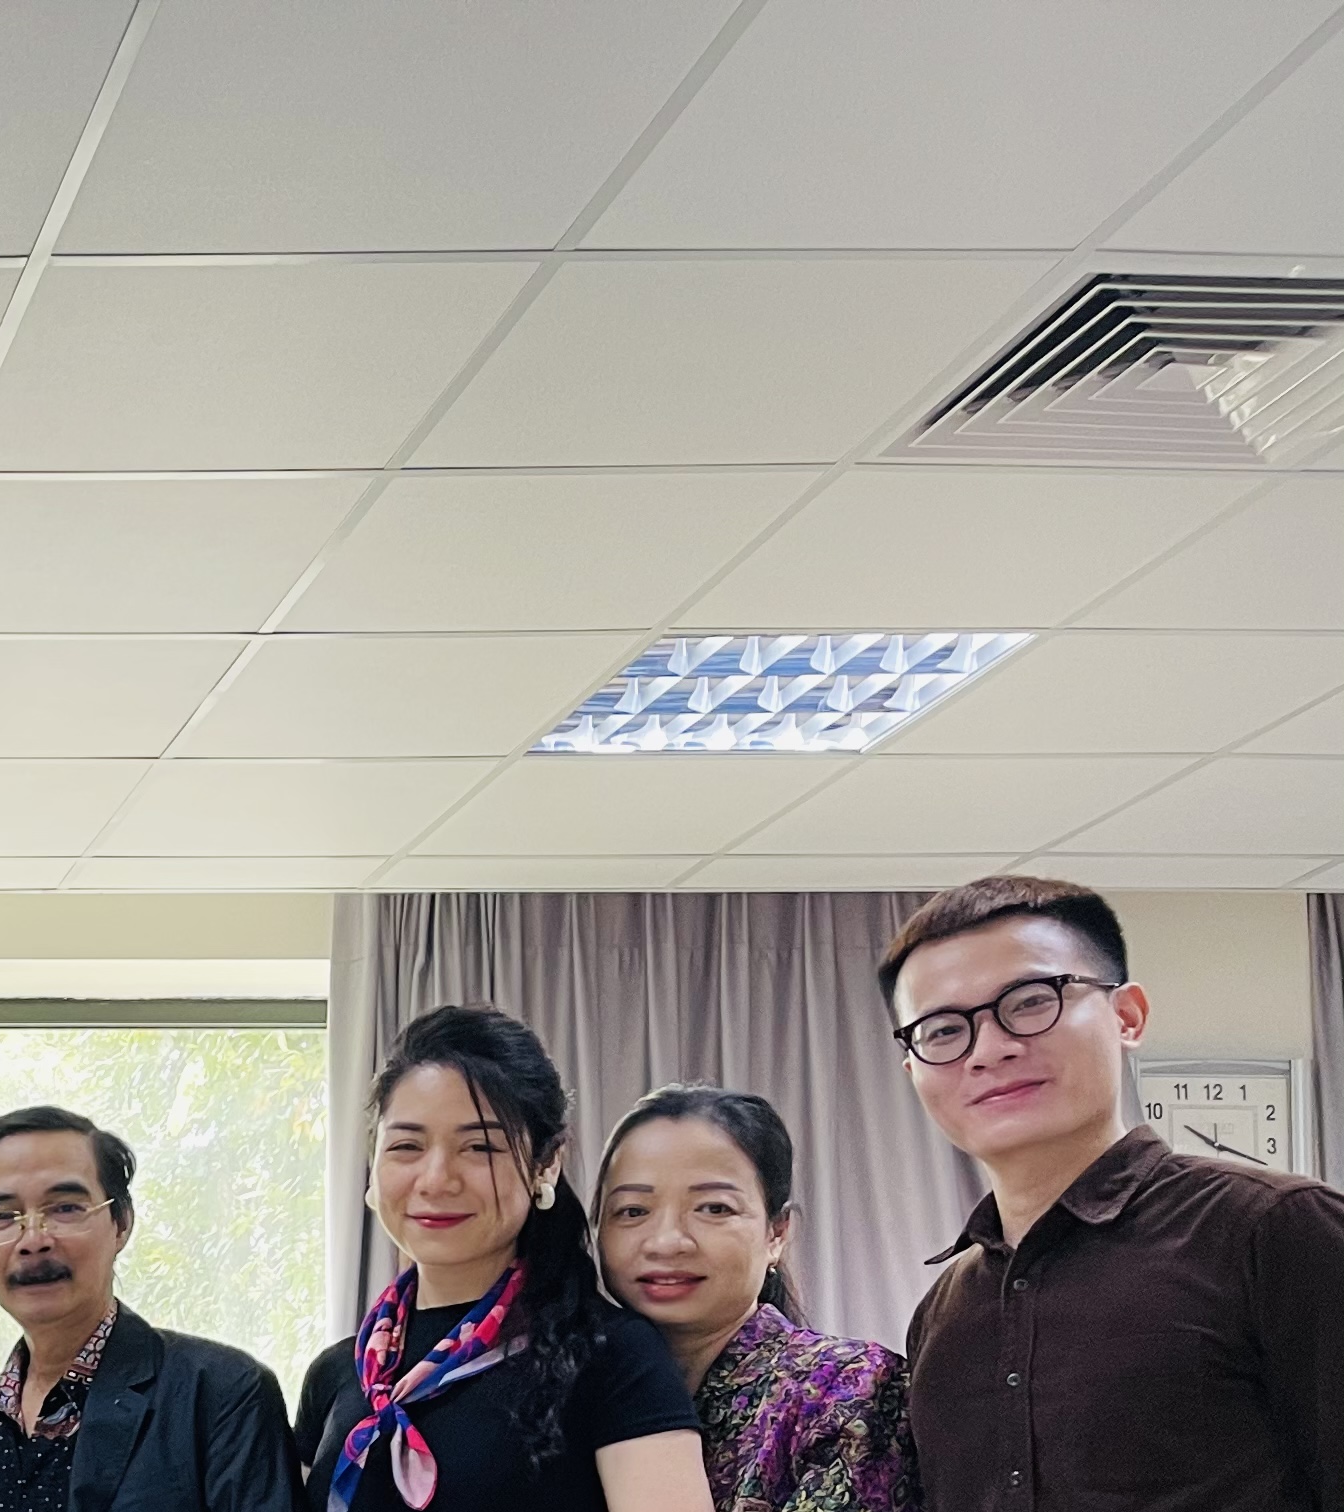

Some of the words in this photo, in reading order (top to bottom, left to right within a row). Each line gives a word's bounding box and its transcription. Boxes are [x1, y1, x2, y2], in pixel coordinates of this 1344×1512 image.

[1173, 1083, 1188, 1101] 11
[1203, 1083, 1223, 1101] 12
[1239, 1084, 1247, 1101] 1
[1144, 1102, 1163, 1120] 10
[1265, 1104, 1276, 1121] 2
[1266, 1137, 1277, 1154] 3
